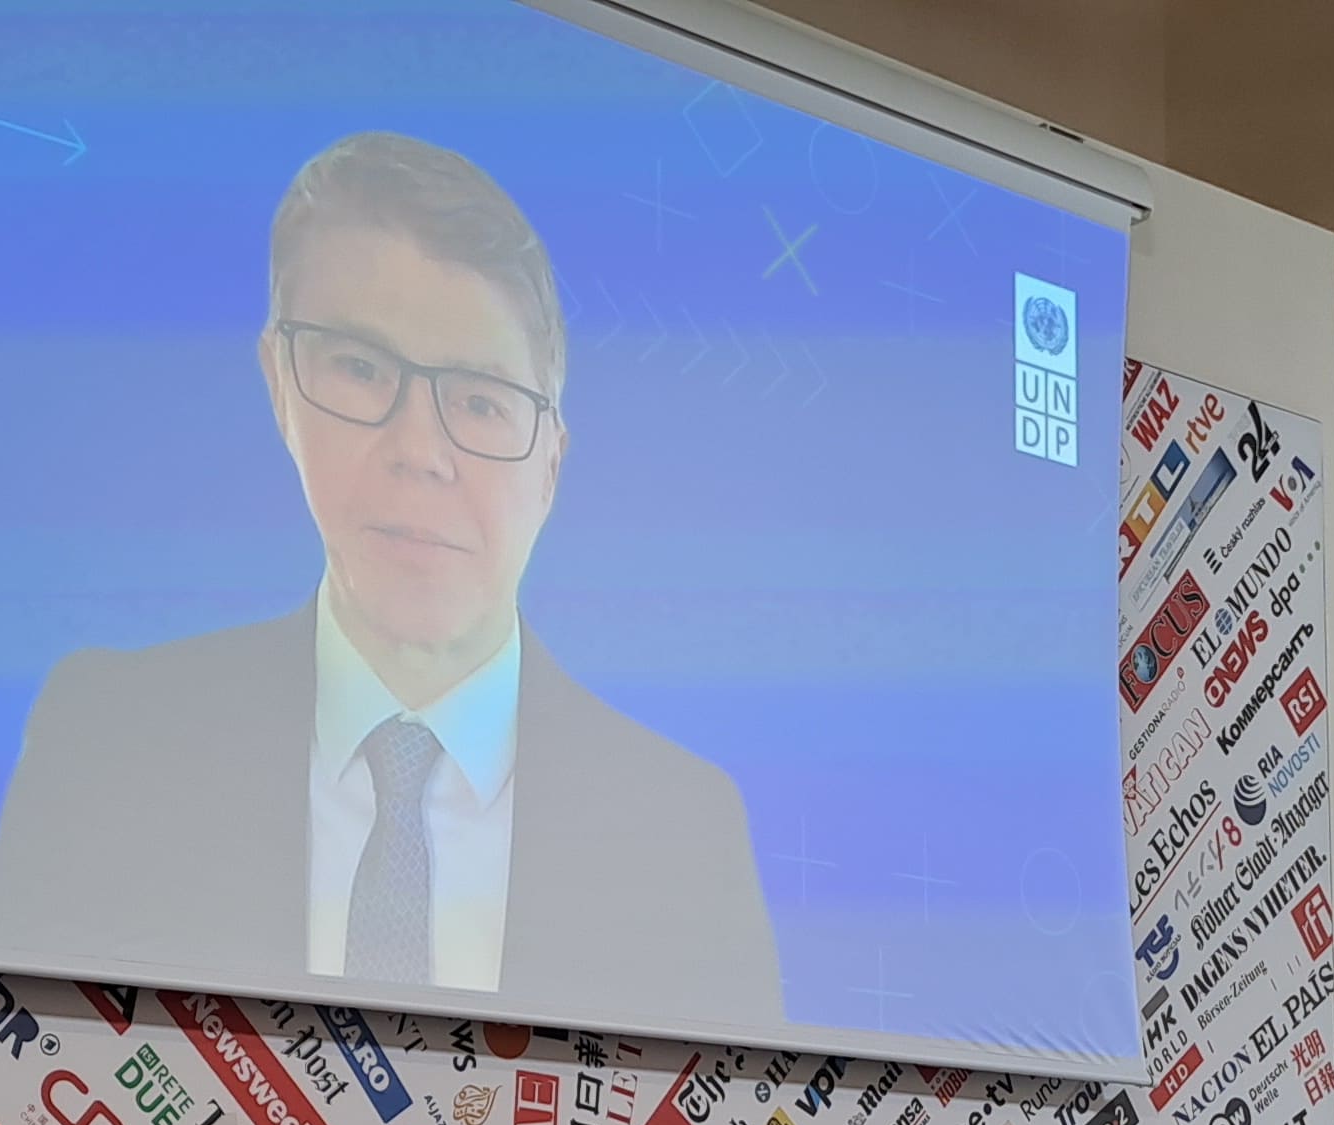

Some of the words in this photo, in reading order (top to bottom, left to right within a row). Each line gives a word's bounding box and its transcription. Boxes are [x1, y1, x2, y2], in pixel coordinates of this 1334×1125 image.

[1130, 376, 1181, 453] WAZ
[1184, 392, 1227, 456] rtve
[1188, 624, 1222, 671] EL
[1224, 526, 1294, 624] MUNDO
[1269, 571, 1302, 619] dpa
[1118, 577, 1207, 706] FOCUS
[1203, 608, 1271, 709] CNEWS
[1215, 622, 1316, 757] Коммерсантъ
[1287, 679, 1323, 726] RSI
[1256, 744, 1286, 780] RIA
[1266, 731, 1323, 799] NOVOSTI
[1179, 927, 1250, 1014] DAGENS
[1195, 959, 1269, 1032] Börsen-Zeitung
[1248, 1014, 1291, 1063] EL
[1290, 1028, 1327, 1077] 光明
[152, 1065, 196, 1117] RETE
[856, 1060, 905, 1117] Mail
[1163, 1062, 1189, 1096] HD
[1248, 1057, 1289, 1101] Deutsche
[1253, 1086, 1279, 1115] Welle
